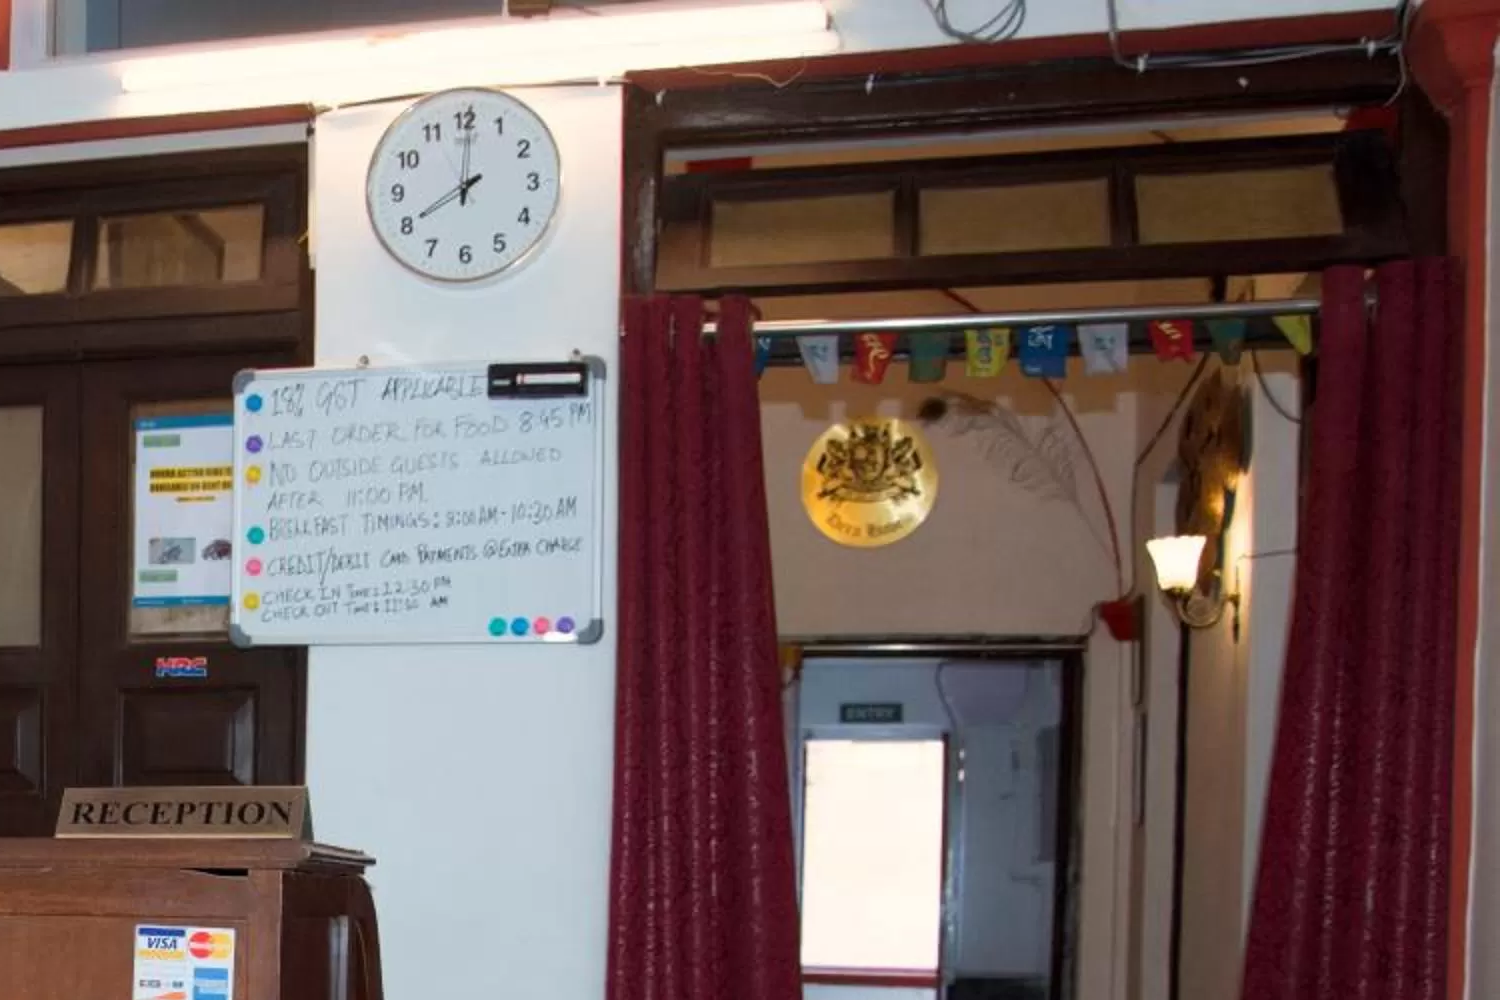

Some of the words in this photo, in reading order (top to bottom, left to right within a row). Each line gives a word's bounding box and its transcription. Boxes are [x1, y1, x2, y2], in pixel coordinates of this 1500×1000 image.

[454, 111, 476, 130] 12
[494, 117, 503, 135] 1
[422, 123, 441, 142] 11
[517, 140, 531, 159] 2
[397, 150, 419, 169] 10
[527, 172, 540, 191] 3
[391, 184, 404, 202] 9
[517, 207, 531, 225] 4
[401, 217, 413, 235] 8
[425, 239, 438, 258] 7
[493, 233, 506, 252] 5
[459, 245, 472, 264] 6
[316, 378, 366, 416] GST
[381, 374, 486, 400] APPLICABLE
[267, 429, 317, 450] LAST
[331, 420, 406, 445] ORDER
[414, 418, 447, 441] FOR
[569, 402, 592, 428] PM
[269, 460, 297, 487] NO
[308, 456, 382, 483] OUTSIDE
[391, 451, 460, 474] GUESTS
[480, 447, 562, 466] ALLOWED
[266, 491, 325, 512] AFTER
[262, 588, 316, 605] CHECK
[320, 585, 341, 600] IN
[261, 605, 311, 623] CHECK
[314, 601, 339, 617] OUT
[71, 801, 294, 826] RECEPTION
[146, 936, 178, 950] VISA
